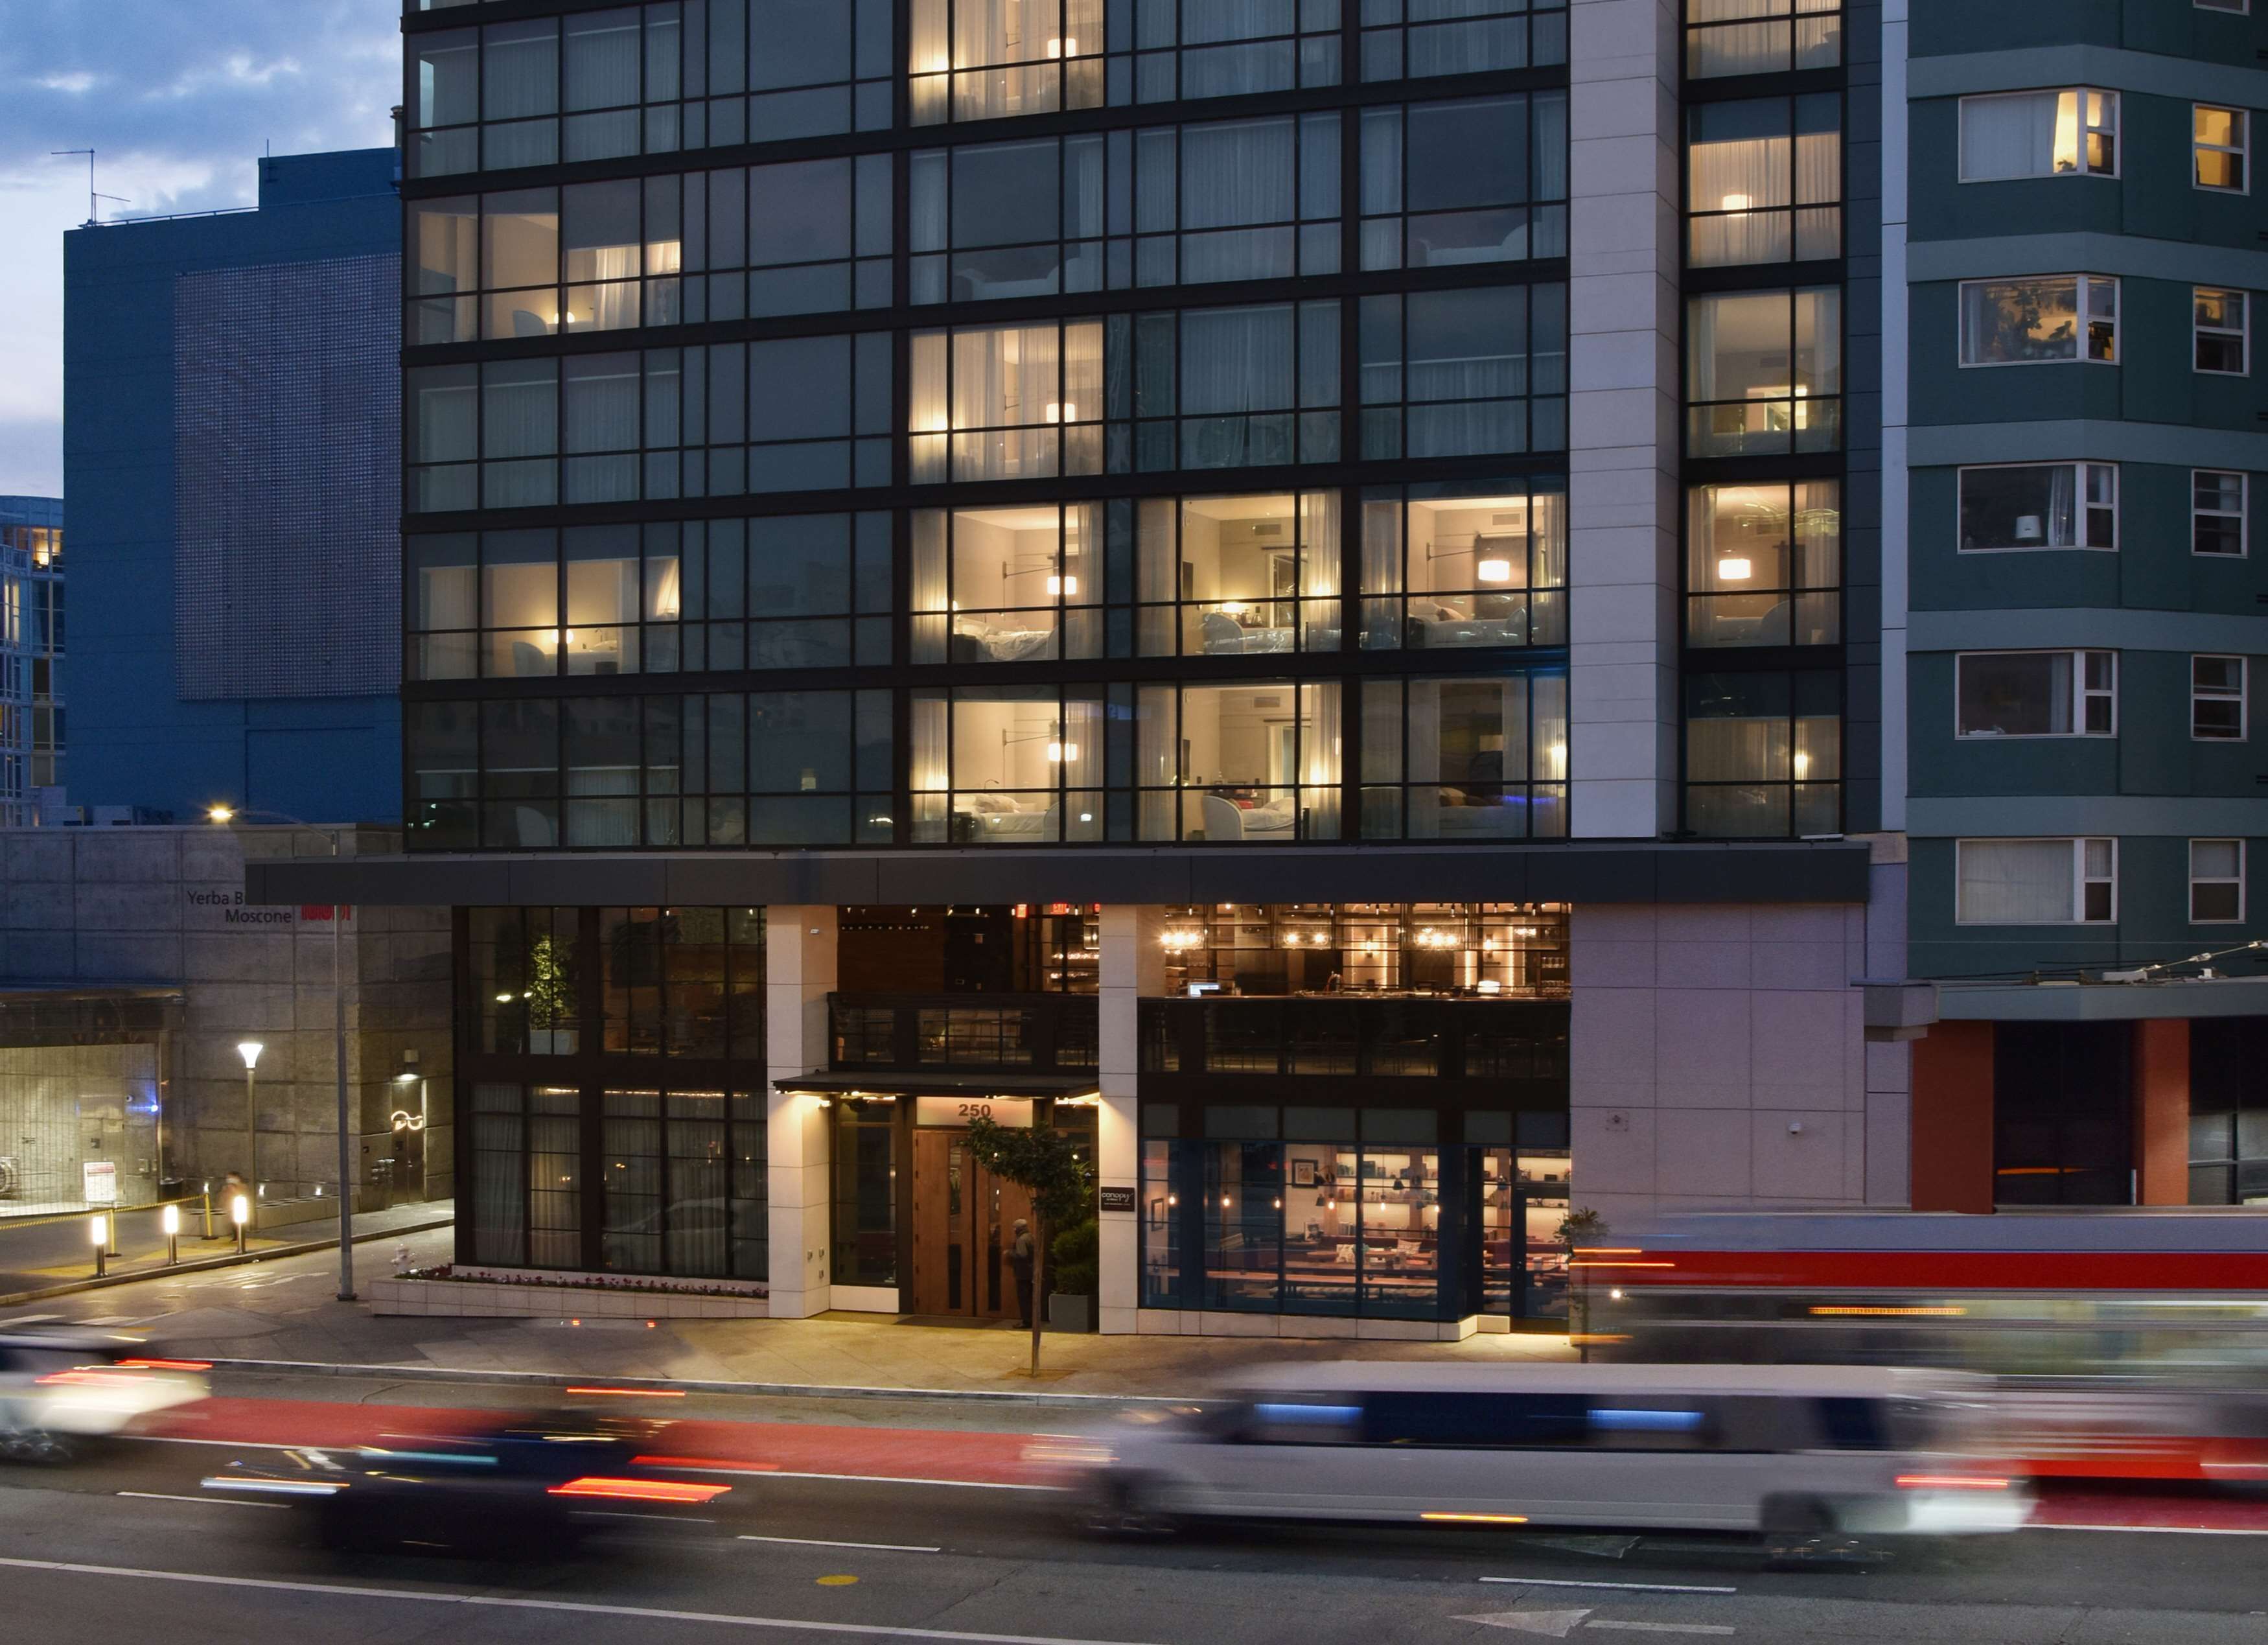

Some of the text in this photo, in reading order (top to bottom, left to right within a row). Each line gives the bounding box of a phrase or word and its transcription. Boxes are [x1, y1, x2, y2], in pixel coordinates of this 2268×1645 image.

[187, 891, 229, 905] Yerba
[226, 909, 292, 924] Moscone
[958, 1103, 991, 1117] 250
[1101, 1193, 1134, 1202] canopy
